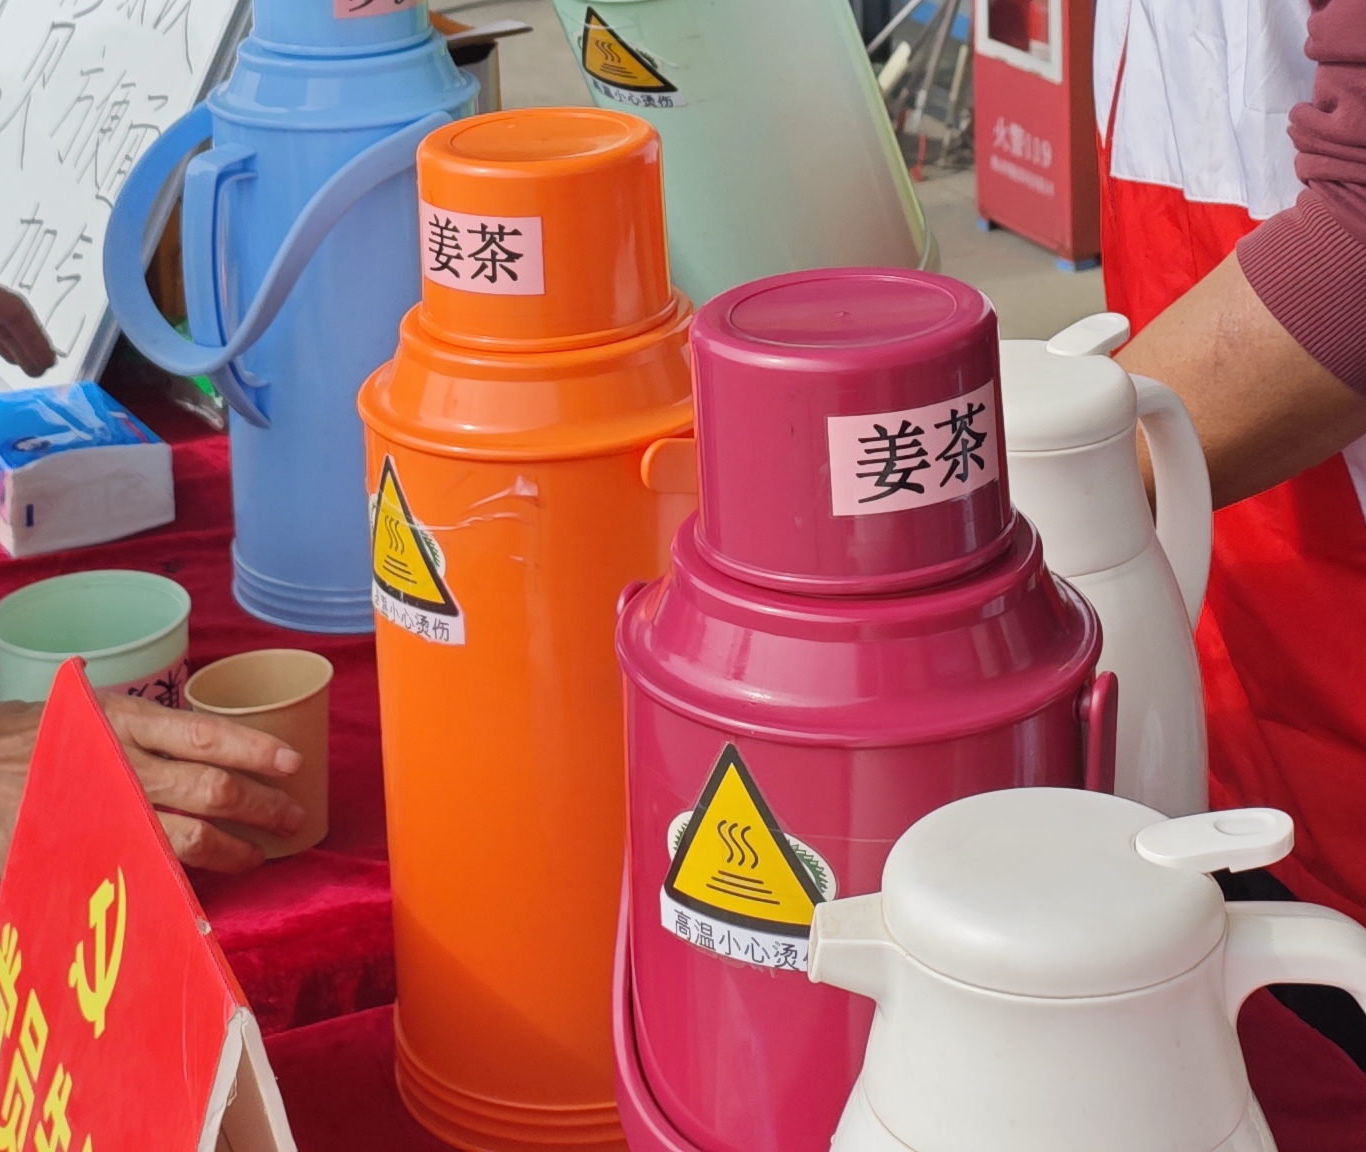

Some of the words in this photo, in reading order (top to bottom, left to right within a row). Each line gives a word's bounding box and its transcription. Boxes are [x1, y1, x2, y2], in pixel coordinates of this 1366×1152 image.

[428, 213, 524, 284] 姜茶
[855, 402, 988, 504] 姜茶
[673, 907, 809, 972] 高温小心烫
